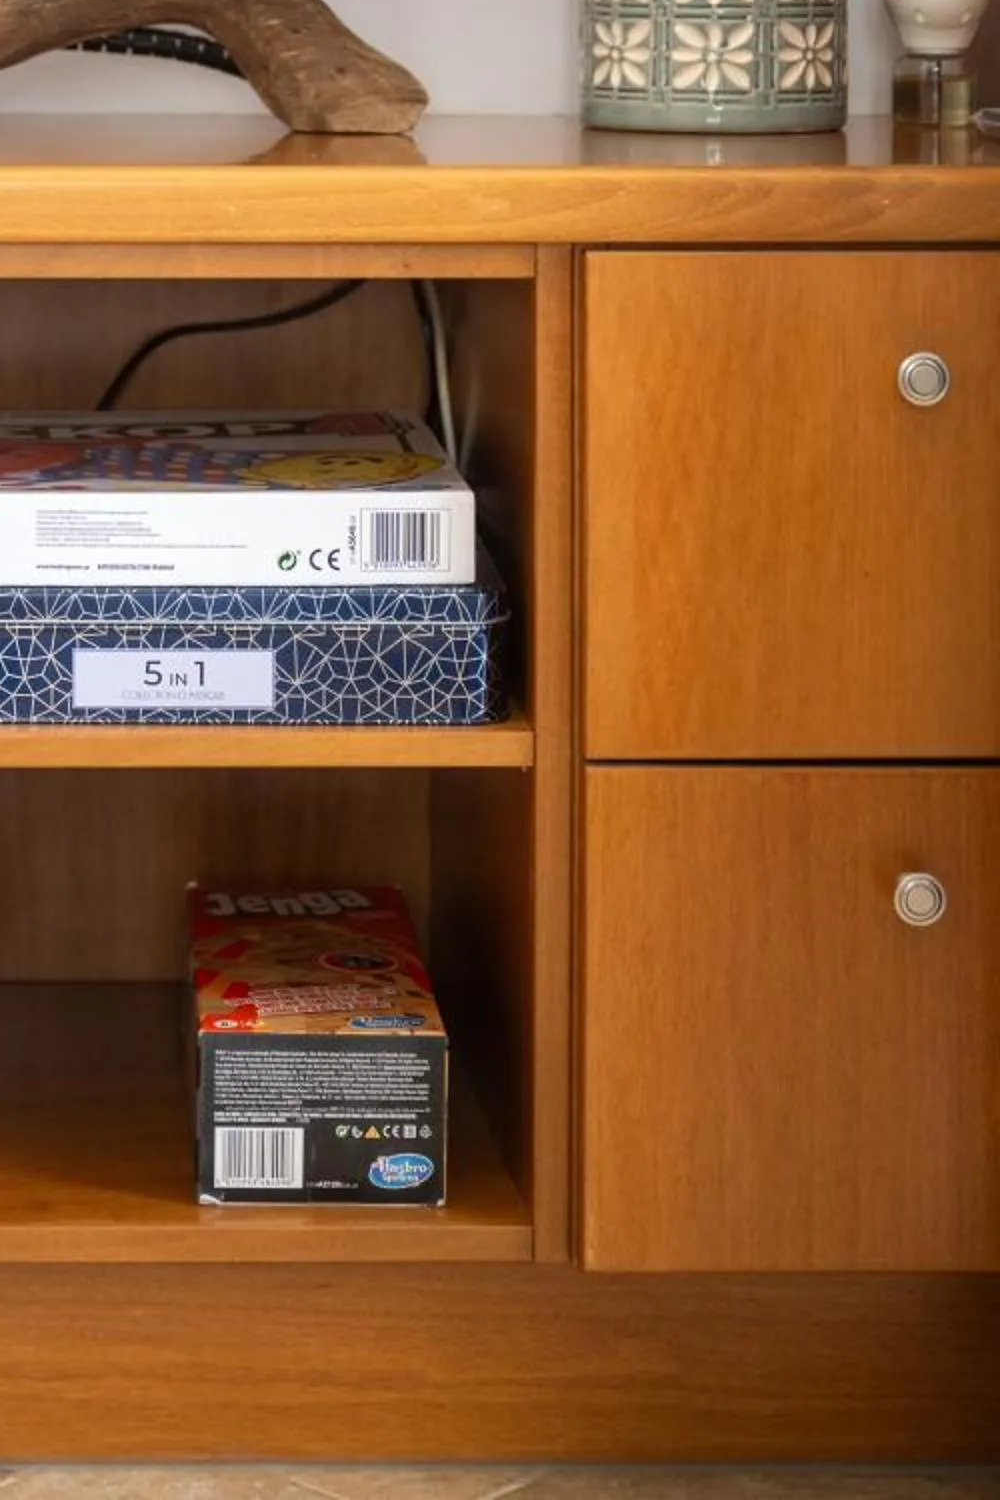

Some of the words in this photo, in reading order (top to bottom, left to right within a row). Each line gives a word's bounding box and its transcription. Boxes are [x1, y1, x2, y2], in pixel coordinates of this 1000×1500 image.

[143, 660, 163, 686] 5
[168, 673, 188, 687] IN
[194, 661, 205, 687] 1
[204, 889, 374, 917] Jenga
